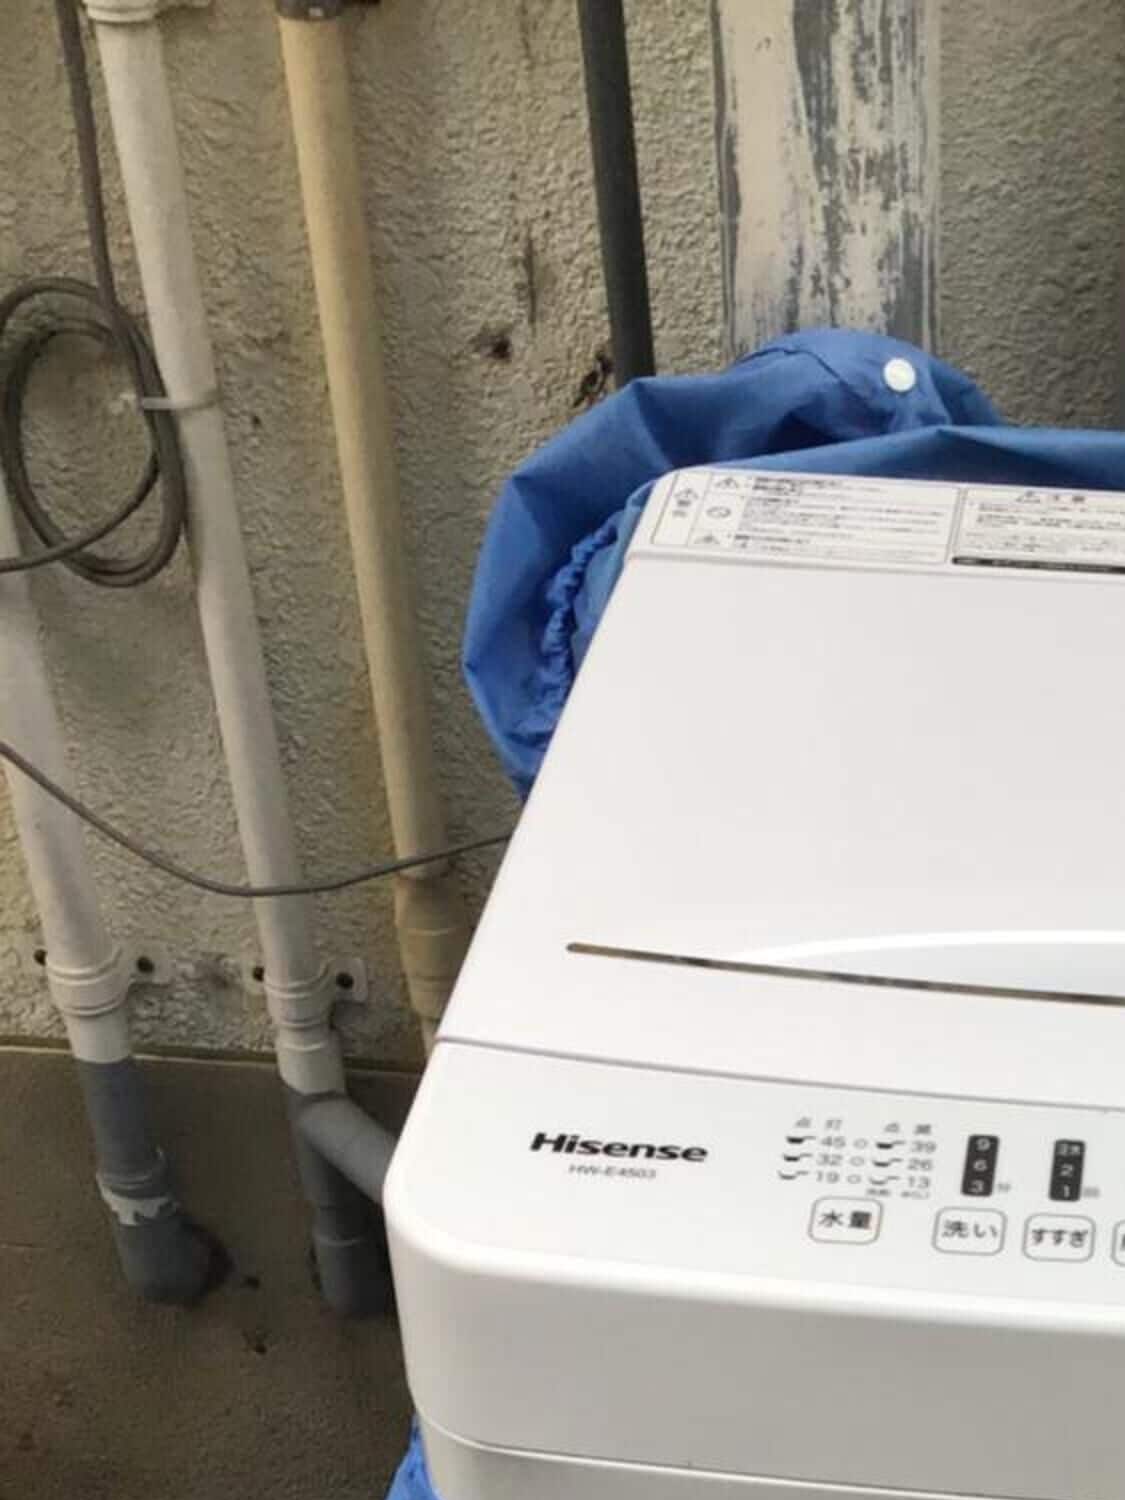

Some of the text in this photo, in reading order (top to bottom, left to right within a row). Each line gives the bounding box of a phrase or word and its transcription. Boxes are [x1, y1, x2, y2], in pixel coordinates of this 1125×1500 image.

[530, 1131, 708, 1162] Hisense
[974, 1137, 991, 1151] 9
[972, 1159, 988, 1172] 6
[818, 1211, 872, 1230] 水量
[941, 1218, 998, 1240] 洗い
[1031, 1228, 1090, 1249] すすぎ
